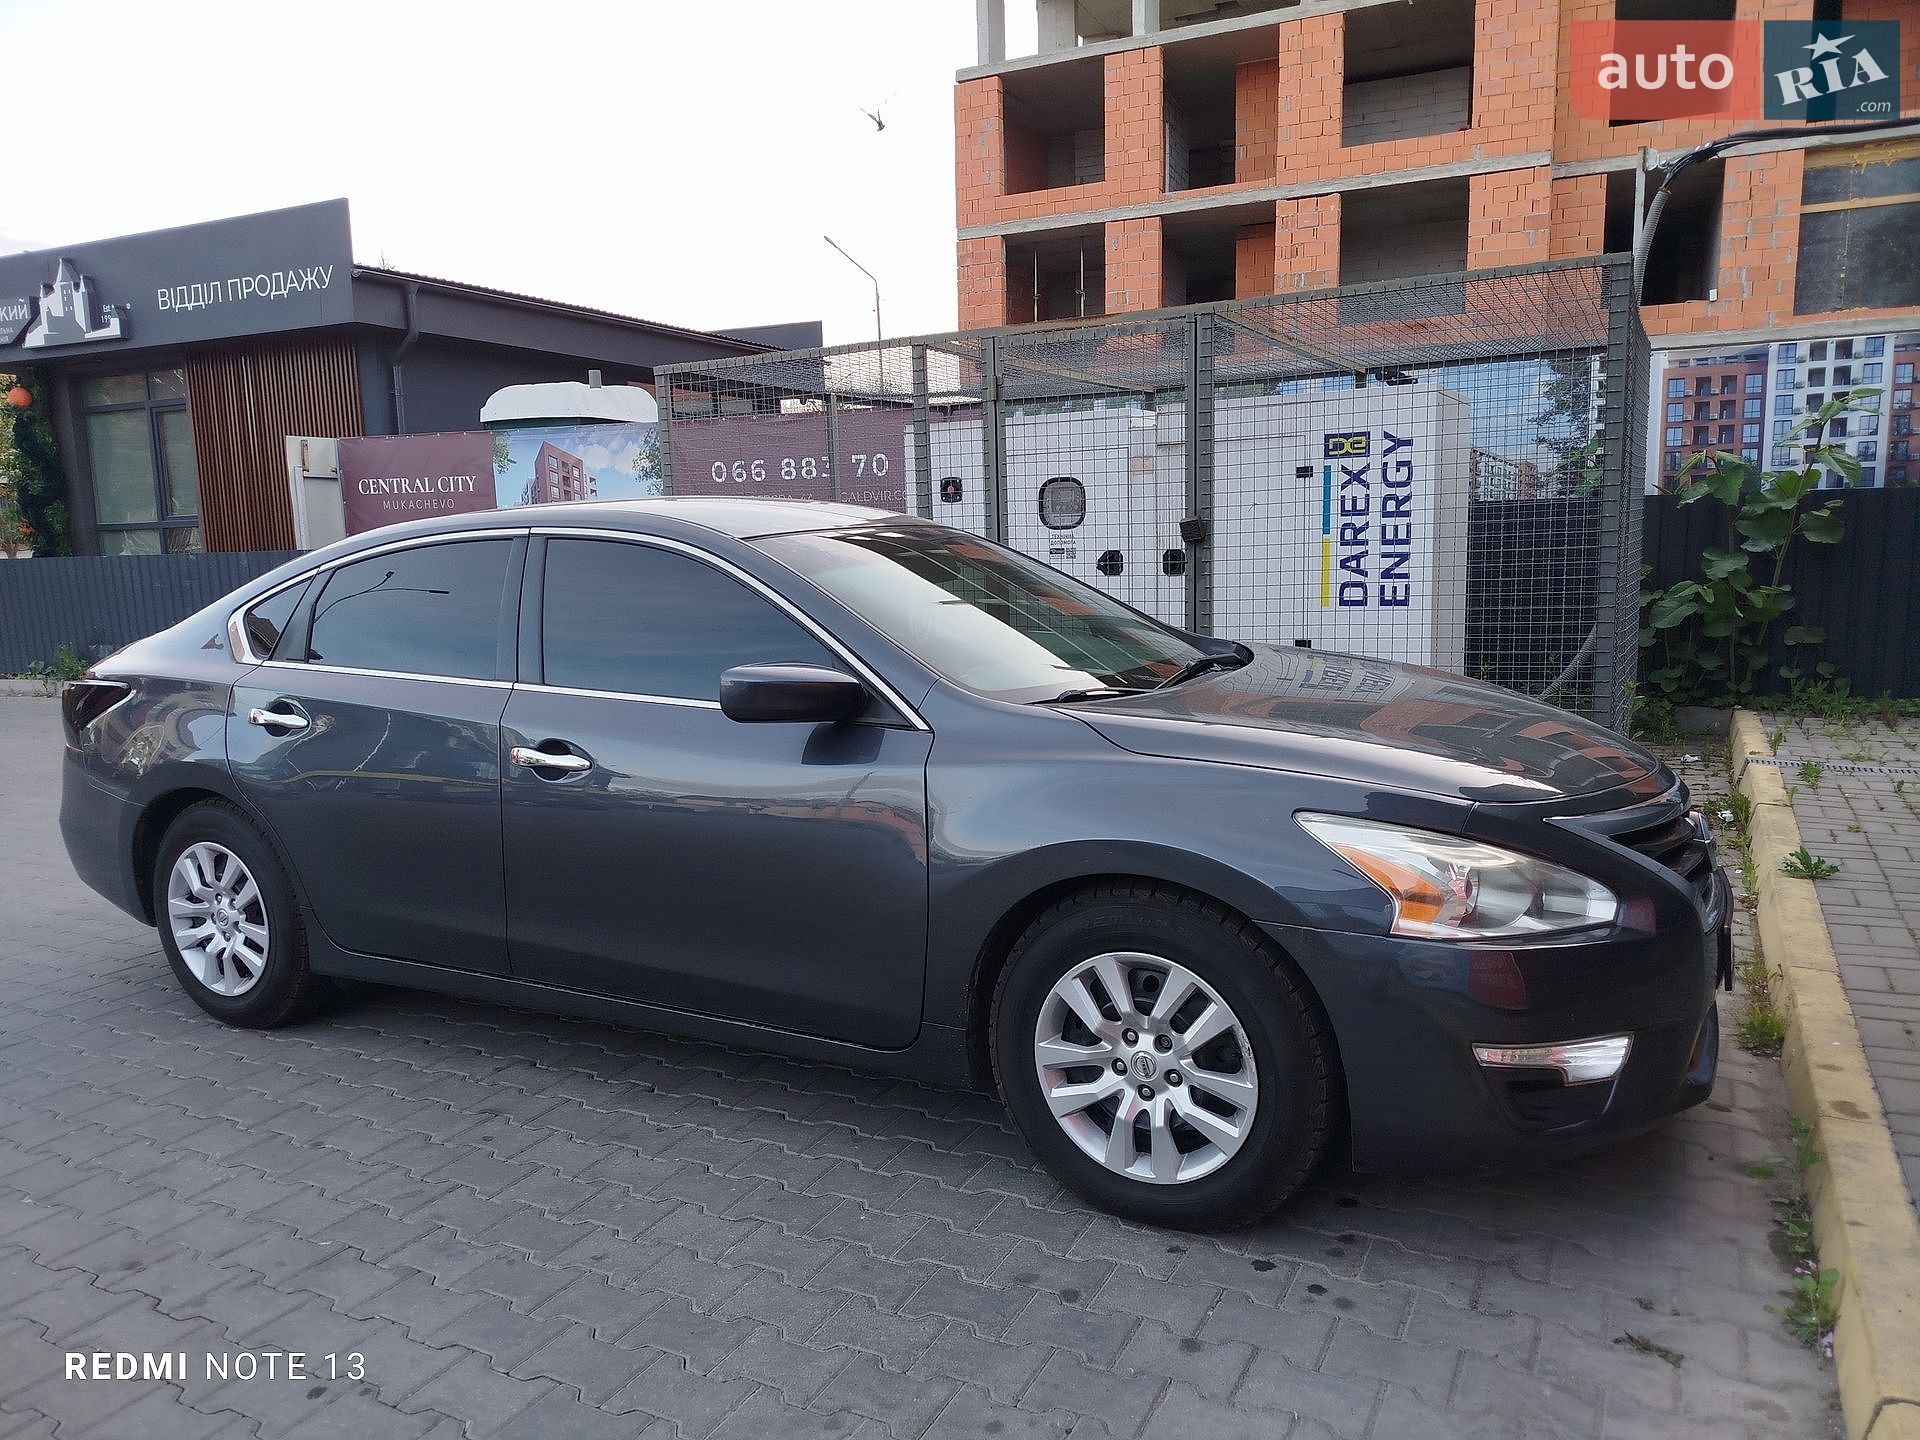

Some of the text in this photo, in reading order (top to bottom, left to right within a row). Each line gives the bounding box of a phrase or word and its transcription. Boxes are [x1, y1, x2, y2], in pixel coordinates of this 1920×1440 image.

[157, 264, 335, 312] ВІДДІЛ ПРОДАЖУ
[358, 475, 476, 496] CENTRAL CITY
[710, 459, 767, 483] 066
[851, 453, 889, 477] 70
[382, 498, 455, 510] MUKACHEVO
[1379, 430, 1414, 607] ENERGY
[1338, 462, 1370, 607] DAREX
